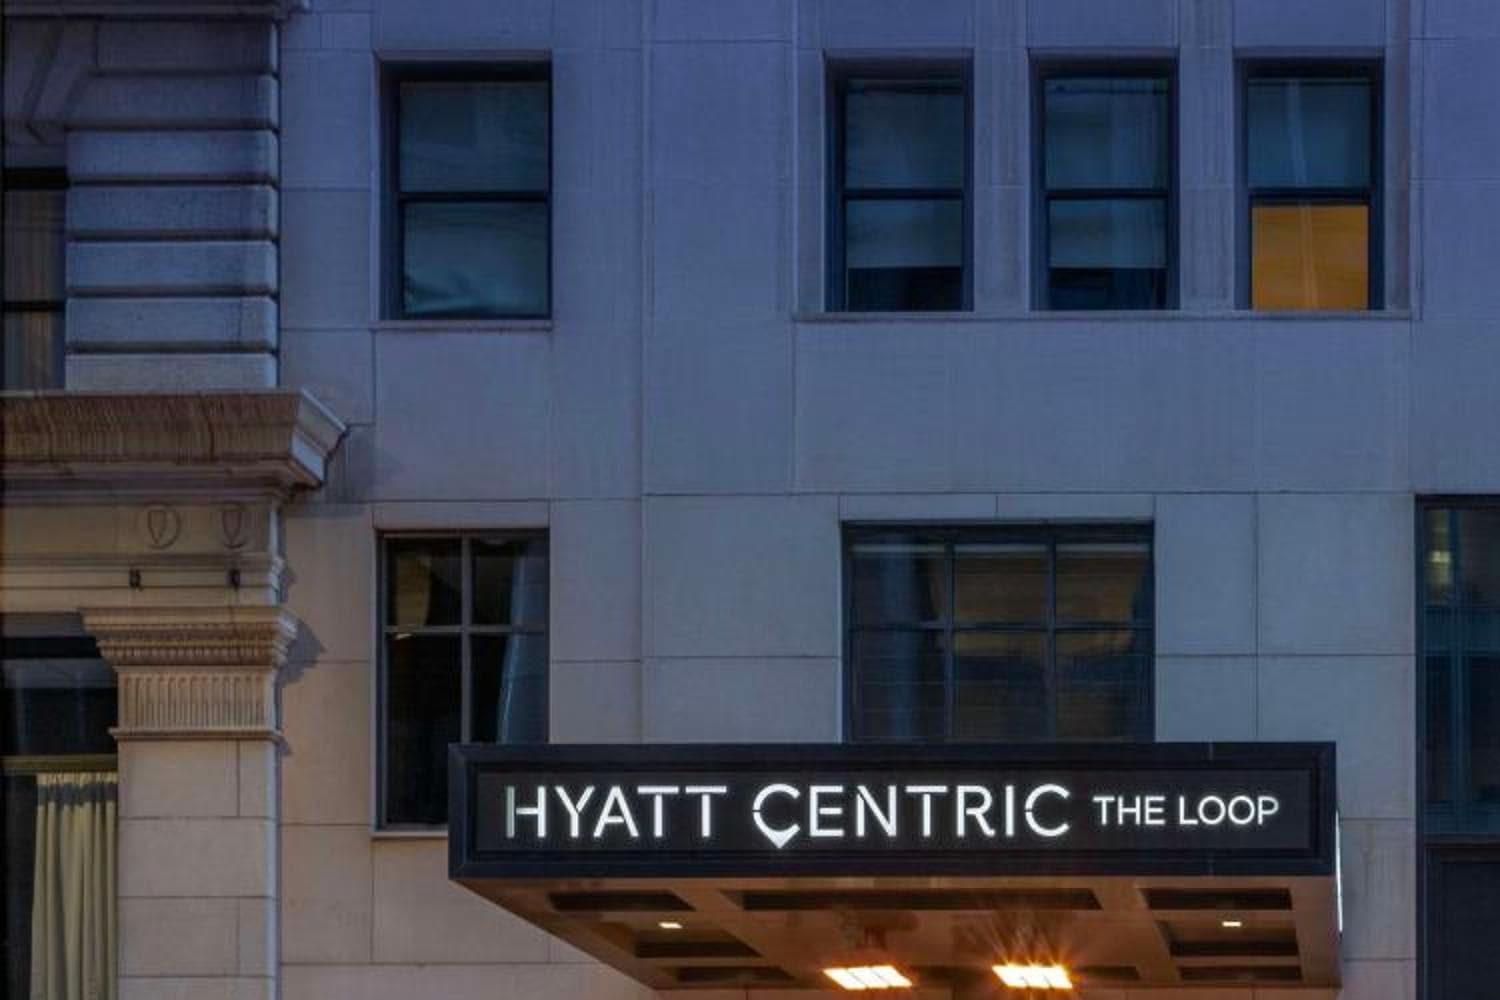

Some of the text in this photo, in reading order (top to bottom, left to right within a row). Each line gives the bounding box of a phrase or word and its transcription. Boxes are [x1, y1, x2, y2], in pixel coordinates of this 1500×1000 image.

[505, 783, 1280, 849] HYATT CENTRIC THE LOOP
